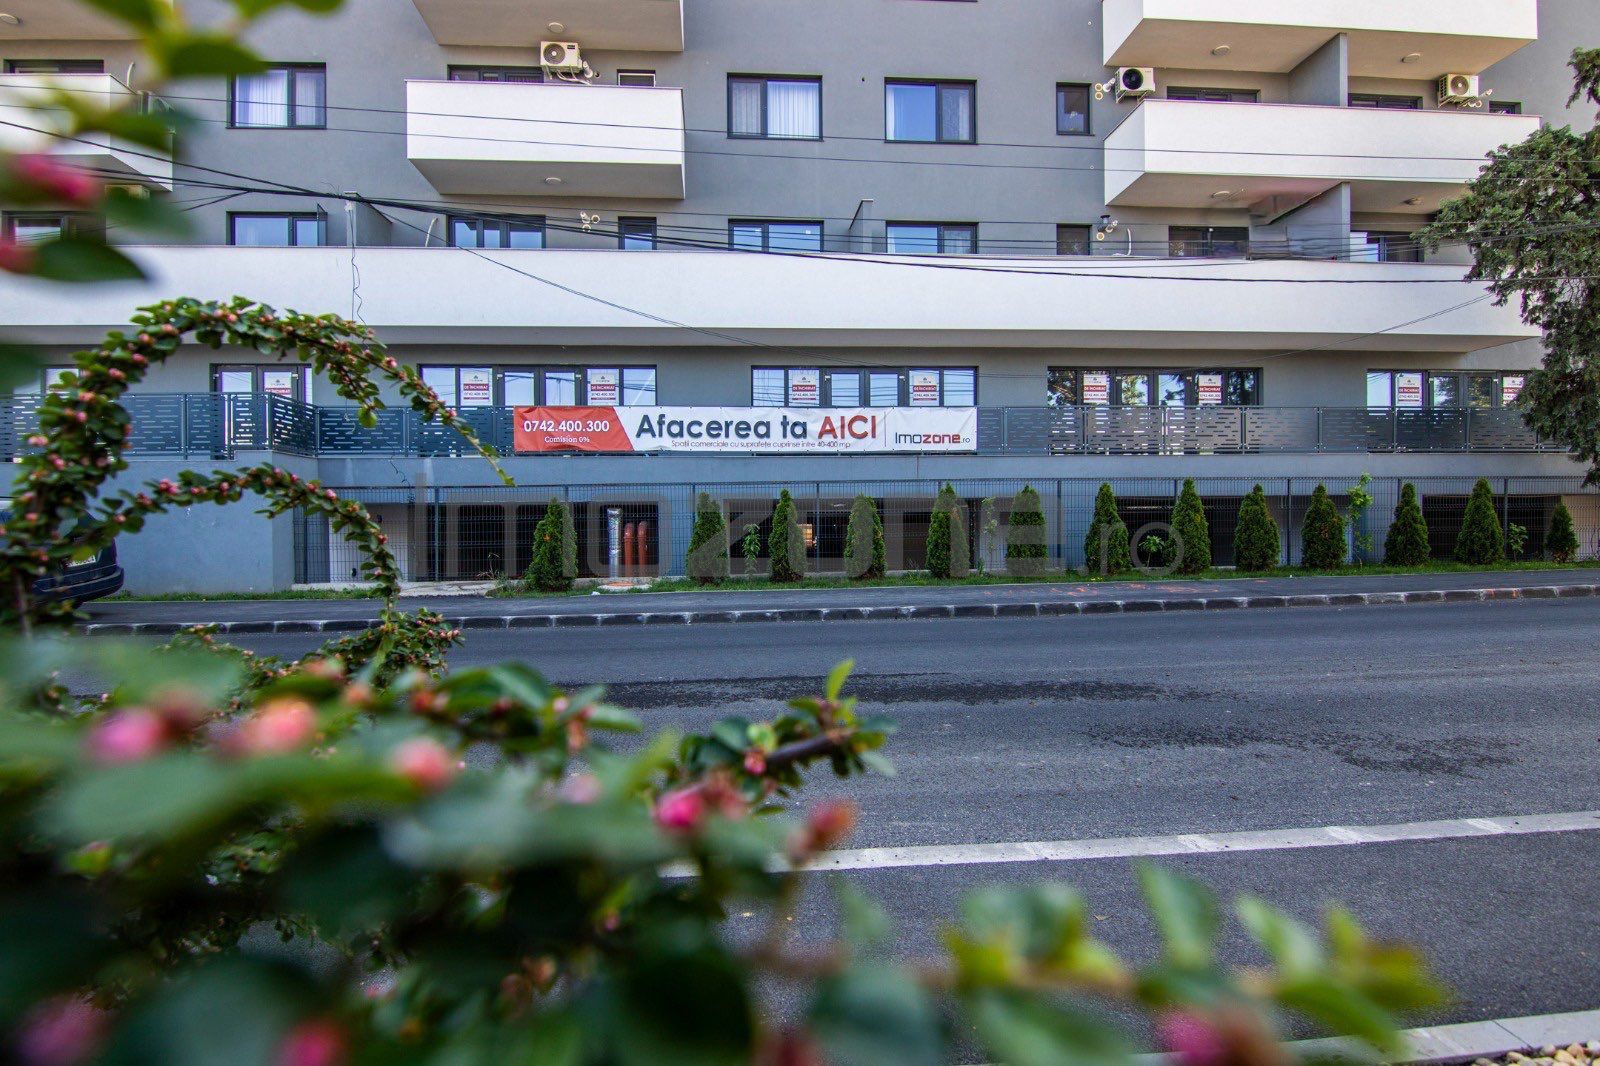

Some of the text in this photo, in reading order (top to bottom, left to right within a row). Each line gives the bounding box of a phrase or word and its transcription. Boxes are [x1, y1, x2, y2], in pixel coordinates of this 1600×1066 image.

[523, 420, 610, 432] 0742.400.300
[635, 414, 876, 439] Afacerea ta AICI
